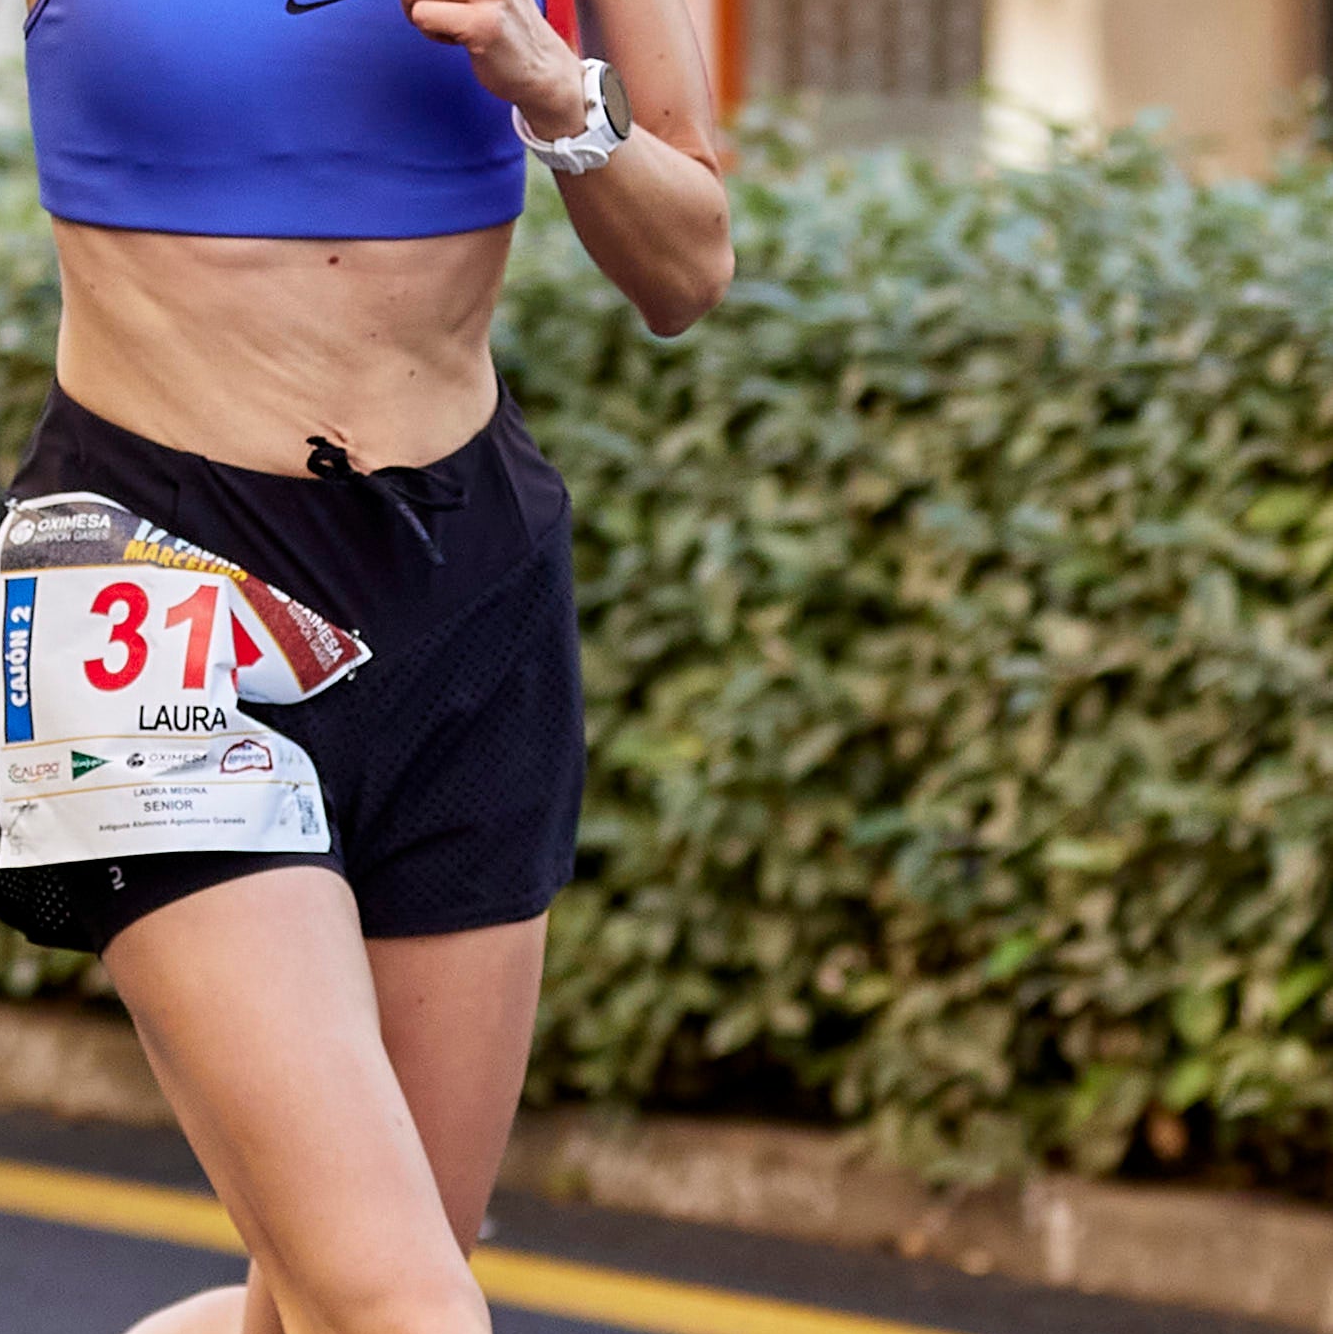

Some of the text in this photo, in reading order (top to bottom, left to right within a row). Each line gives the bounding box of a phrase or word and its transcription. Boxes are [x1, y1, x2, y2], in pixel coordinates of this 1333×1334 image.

[37, 513, 111, 532] OXIMESA
[5, 605, 32, 707] CAJÓN 2
[139, 704, 227, 731] LAURA
[133, 786, 207, 797] LAURA MEDINA
[143, 799, 194, 812] SENIOR
